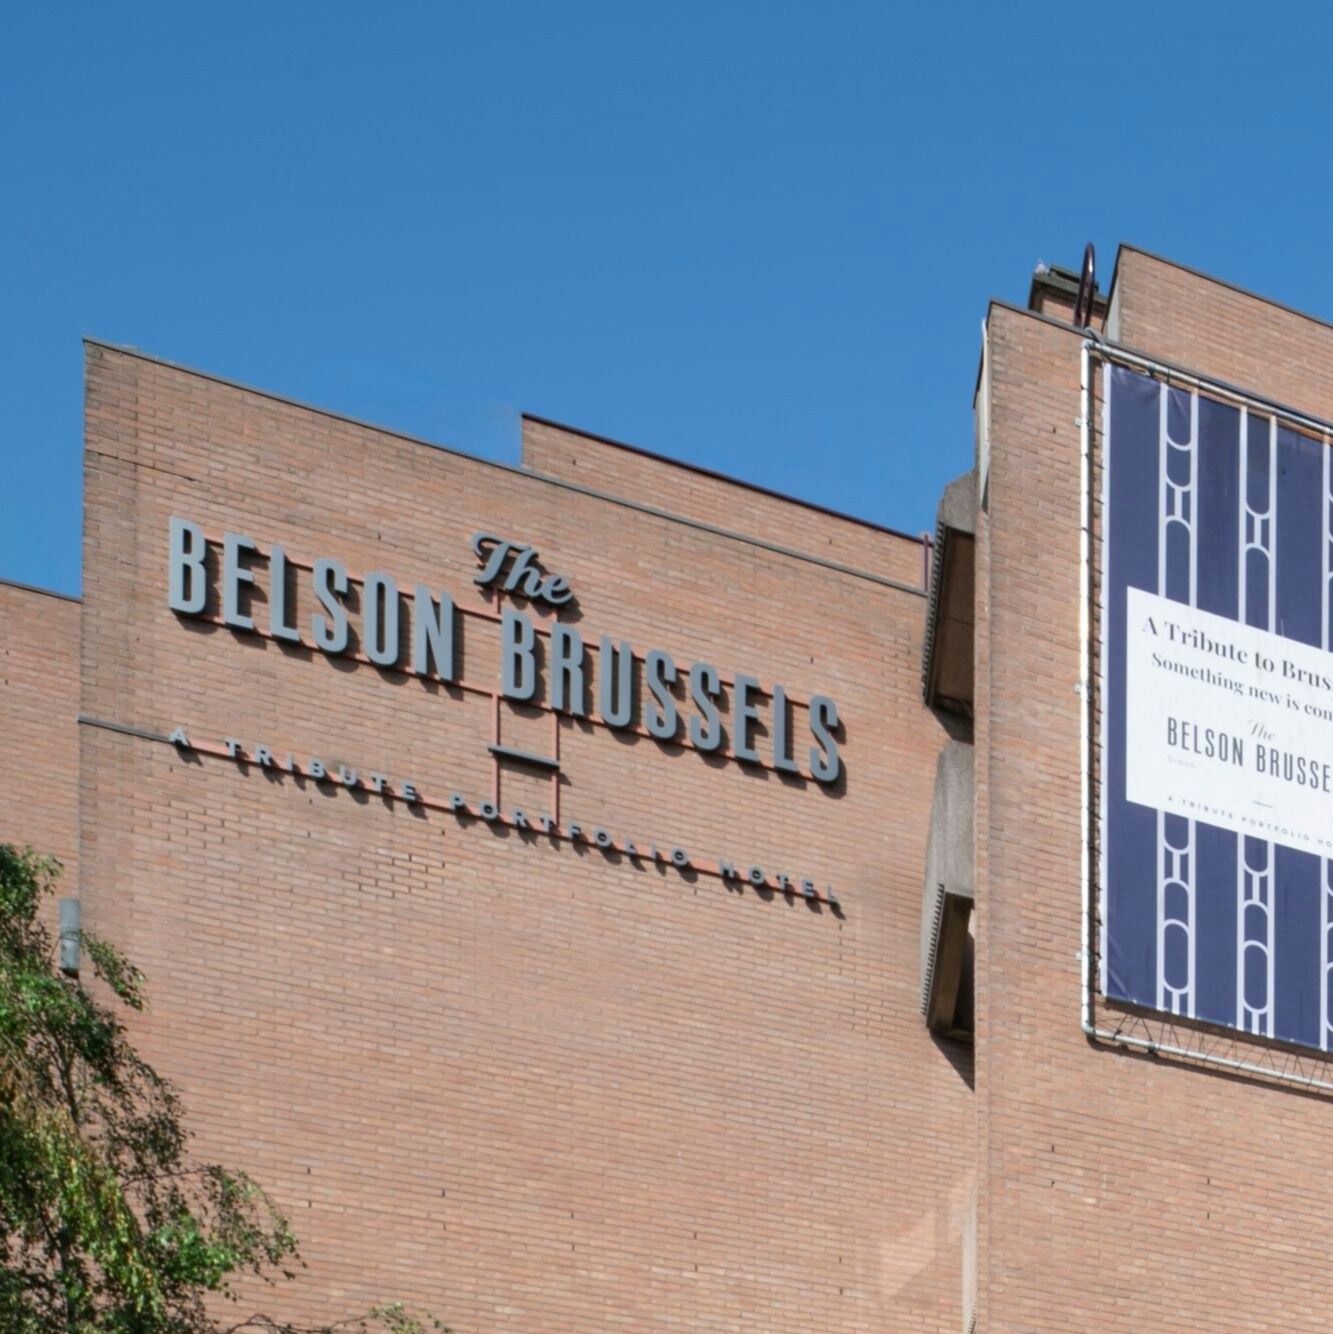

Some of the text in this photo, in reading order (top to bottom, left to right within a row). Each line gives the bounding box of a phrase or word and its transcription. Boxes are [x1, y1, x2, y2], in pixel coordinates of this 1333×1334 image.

[472, 532, 573, 604] The
[169, 516, 839, 783] BELSON BRUSSELS
[1142, 616, 1158, 637] A
[1164, 621, 1248, 665] Tribute
[1254, 651, 1275, 673] to
[1152, 652, 1244, 697] Something
[1249, 684, 1282, 705] new
[1287, 694, 1299, 711] is
[1167, 717, 1244, 767] BELSON
[1248, 718, 1276, 741] The
[169, 726, 838, 903] A TRIBUTE PORTFOLIO HOTEL
[1182, 798, 1233, 820] TRIBUTE
[1241, 816, 1310, 842] PORTFOLIO
